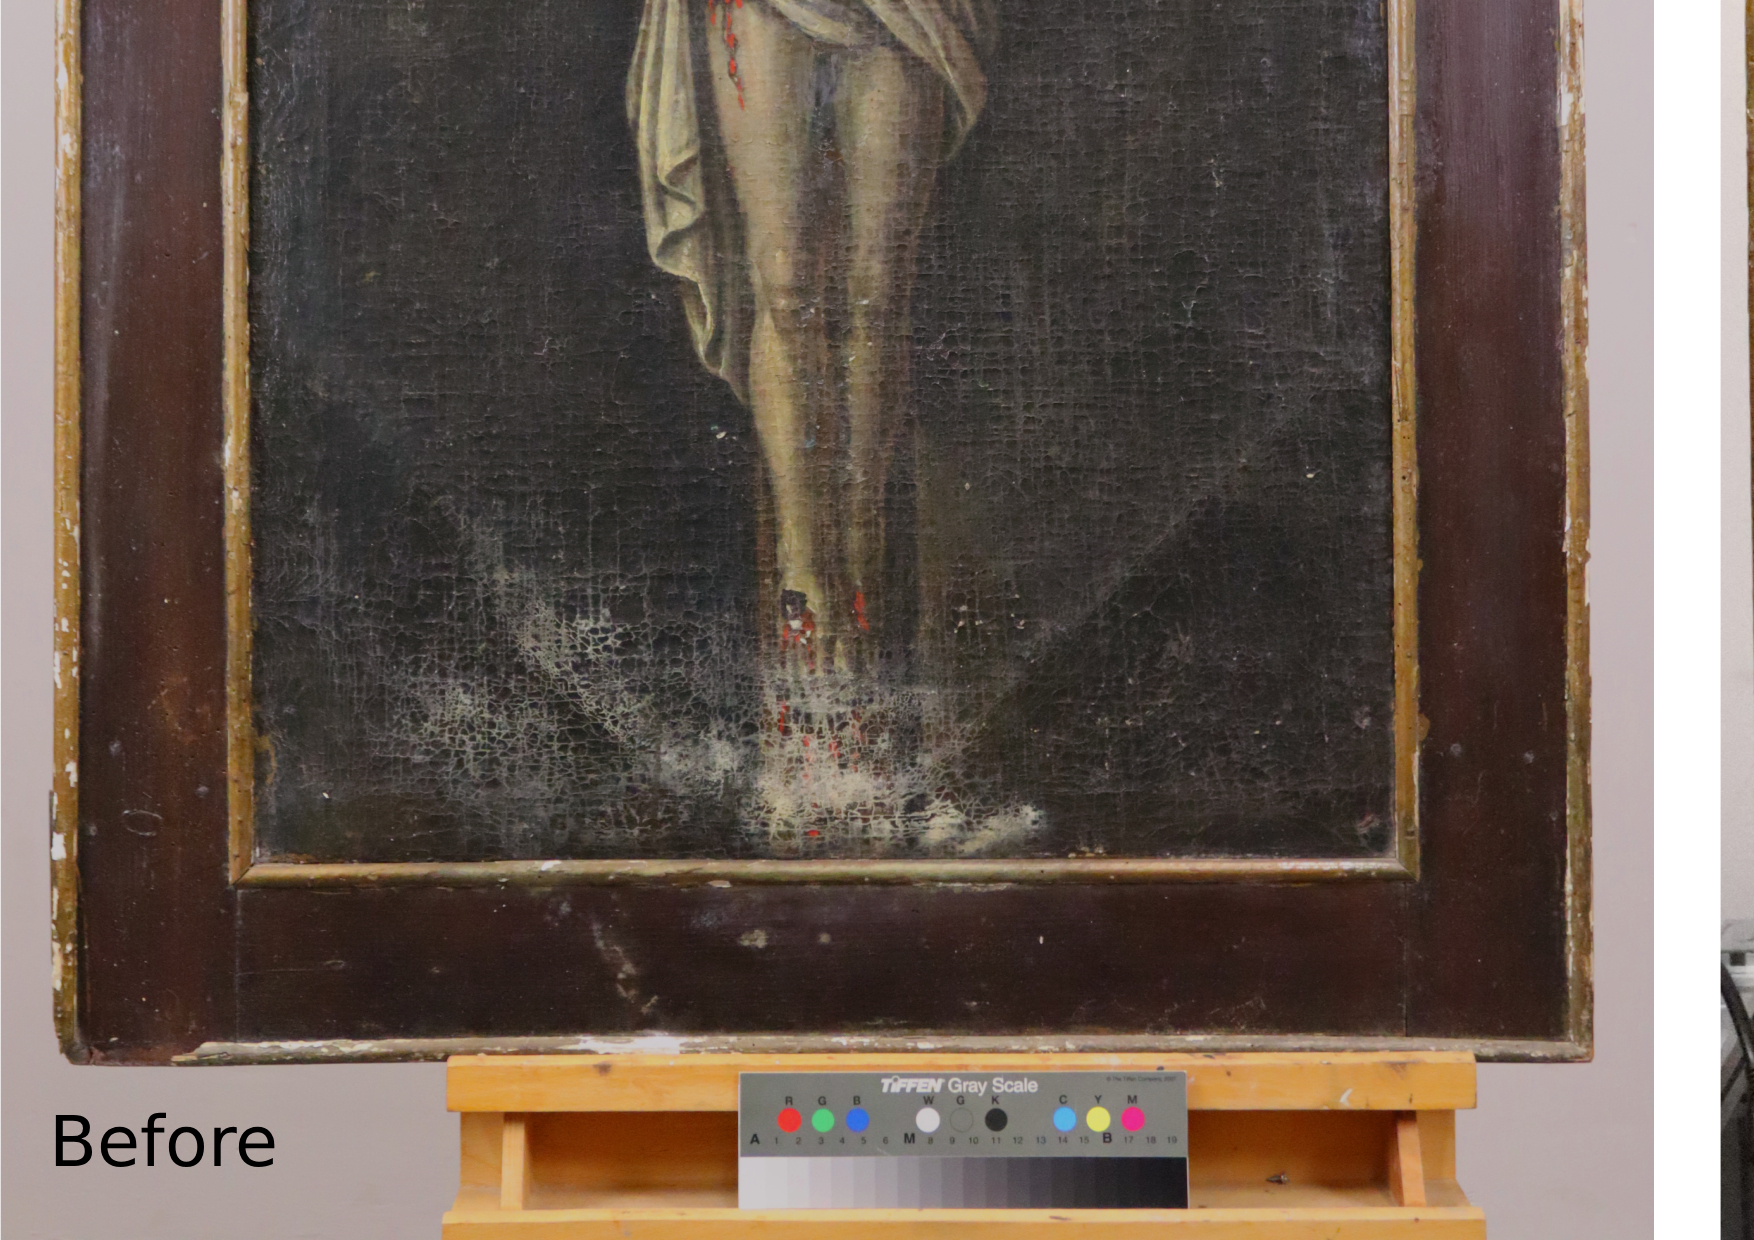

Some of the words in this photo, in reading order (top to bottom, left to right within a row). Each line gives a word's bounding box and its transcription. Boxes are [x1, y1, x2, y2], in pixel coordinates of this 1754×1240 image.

[948, 1077, 988, 1096] Gray
[992, 1077, 1038, 1093] Scale
[785, 1096, 793, 1106] R
[818, 1096, 827, 1106] G
[853, 1096, 861, 1105] B
[923, 1096, 934, 1105] W
[956, 1095, 965, 1105] G
[991, 1095, 1000, 1105] K
[1059, 1095, 1068, 1105] C
[1094, 1095, 1102, 1104] Y
[1127, 1095, 1138, 1104] M
[750, 1133, 760, 1145] A
[796, 1136, 802, 1145] 2
[819, 1136, 825, 1145] 3
[840, 1136, 846, 1145] 4
[861, 1136, 867, 1145] 5
[883, 1136, 889, 1145] 6
[904, 1133, 915, 1144] M
[928, 1136, 934, 1145] 8
[950, 1136, 956, 1145] 9
[969, 1136, 979, 1144] 10
[992, 1136, 1001, 1144] 11
[1013, 1136, 1024, 1144] 12
[1037, 1136, 1047, 1144] 13
[1059, 1136, 1068, 1144] 14
[1080, 1135, 1090, 1144] 15
[1103, 1132, 1112, 1143] B
[1125, 1135, 1134, 1144] 17
[1147, 1135, 1157, 1144] 18
[1168, 1135, 1178, 1144] 19
